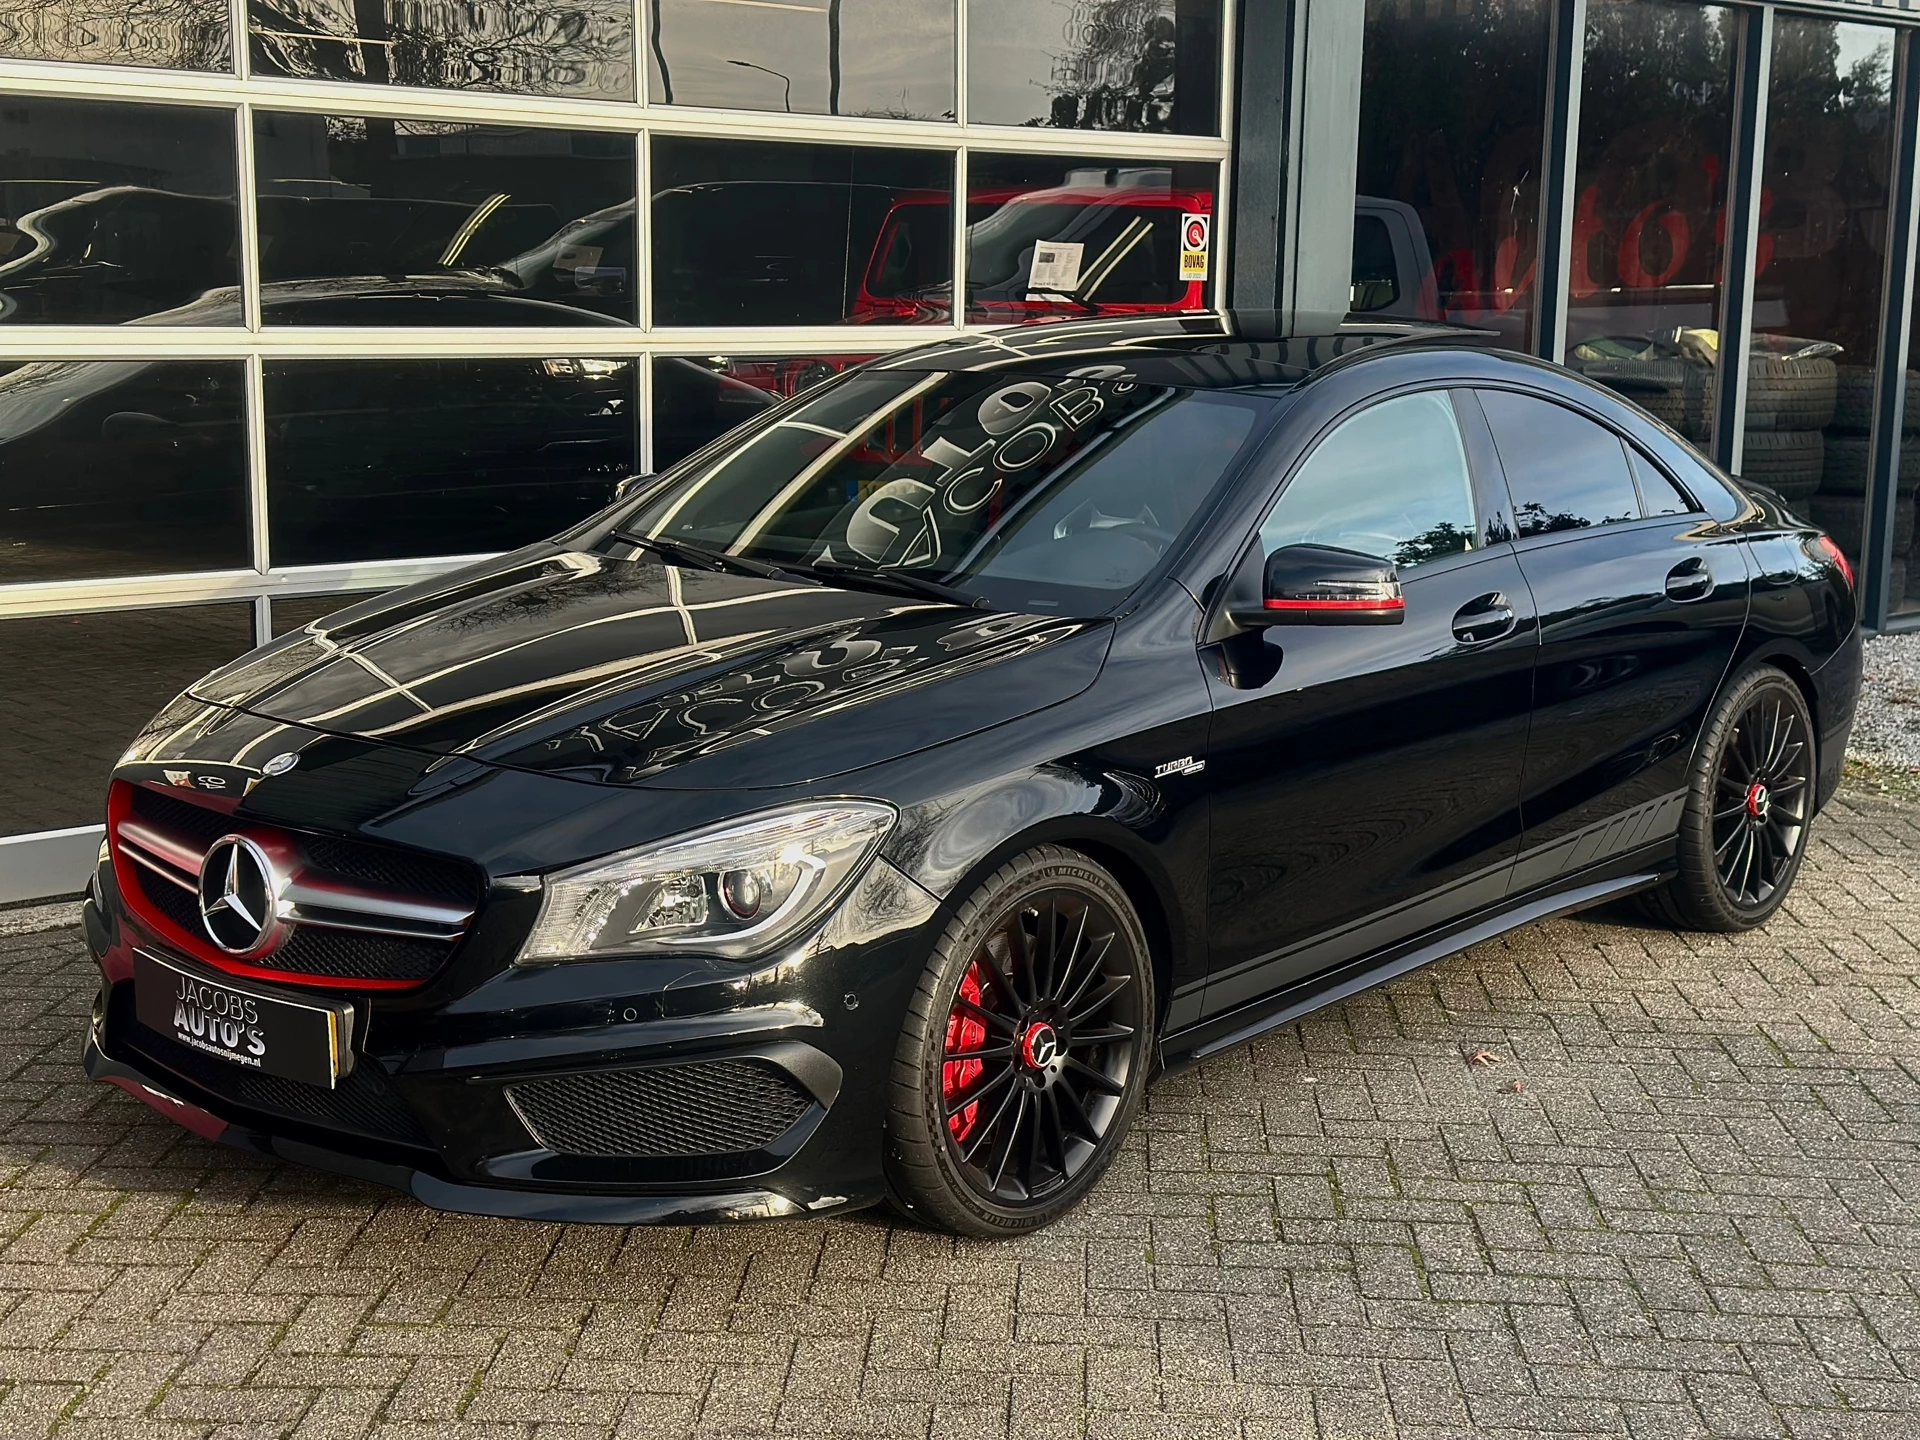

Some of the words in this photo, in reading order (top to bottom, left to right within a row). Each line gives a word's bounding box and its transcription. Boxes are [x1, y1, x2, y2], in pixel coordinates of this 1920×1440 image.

[1184, 254, 1205, 269] BOVAG
[1155, 756, 1193, 775] TURBO
[1058, 866, 1106, 888] MICHELIN
[176, 977, 258, 1024] JACOBS
[174, 1000, 266, 1055] AUTO'S
[177, 1031, 261, 1067] www.jacobsautosnijmegen.nl
[982, 1211, 1034, 1228] MICHELIN
